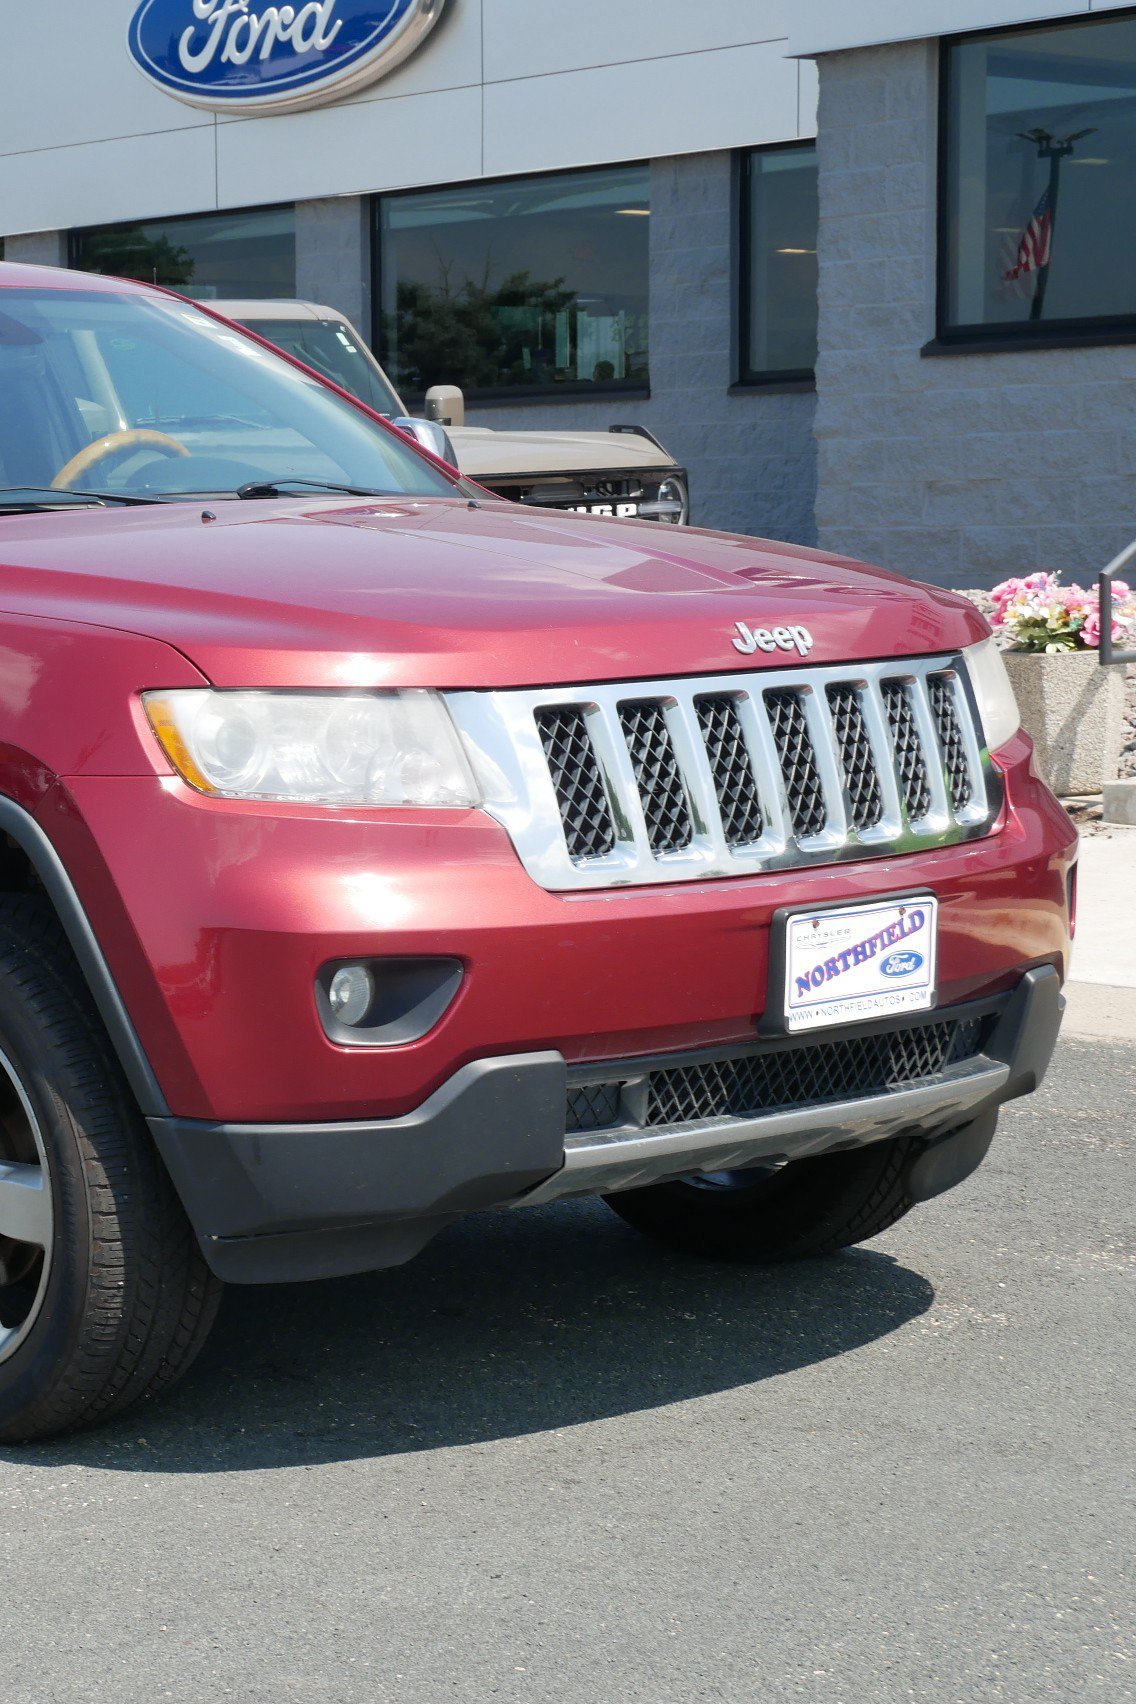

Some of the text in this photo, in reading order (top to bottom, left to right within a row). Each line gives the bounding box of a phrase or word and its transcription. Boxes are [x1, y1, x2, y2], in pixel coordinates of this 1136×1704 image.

[178, 0, 344, 74] Ford
[731, 621, 814, 657] Jeep
[796, 928, 851, 942] CHRYSLER
[795, 909, 925, 998] NORTHFIELD
[886, 954, 916, 974] Ford
